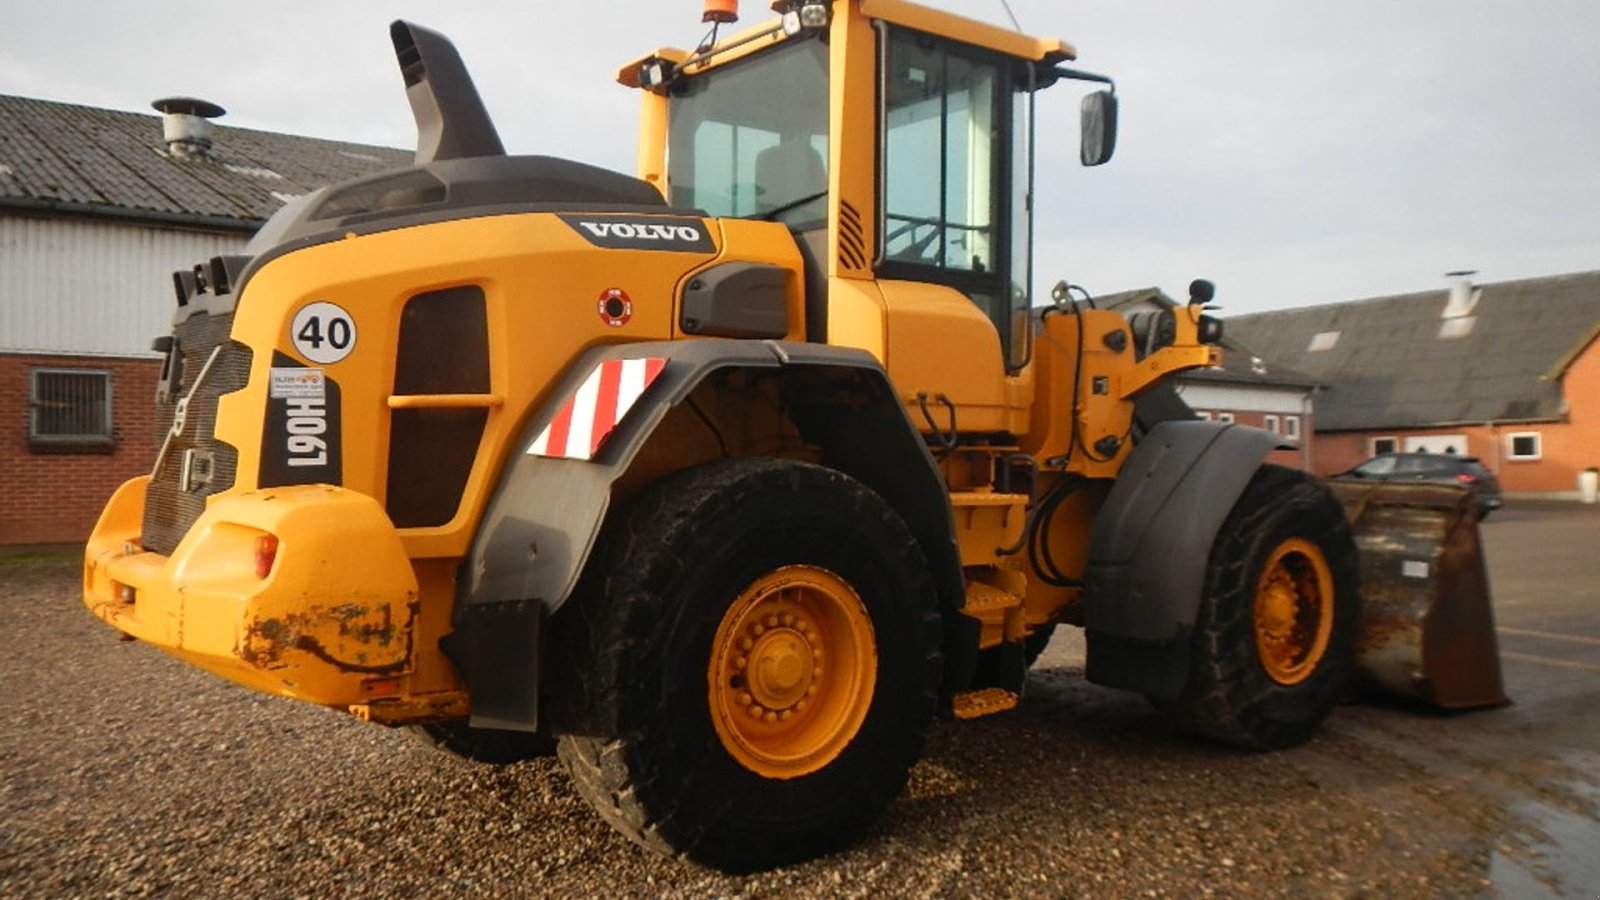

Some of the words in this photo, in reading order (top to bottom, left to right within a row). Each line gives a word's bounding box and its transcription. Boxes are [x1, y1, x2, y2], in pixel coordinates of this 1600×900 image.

[580, 222, 700, 241] VOLVO
[298, 316, 351, 350] 40
[286, 397, 328, 466] L90H
